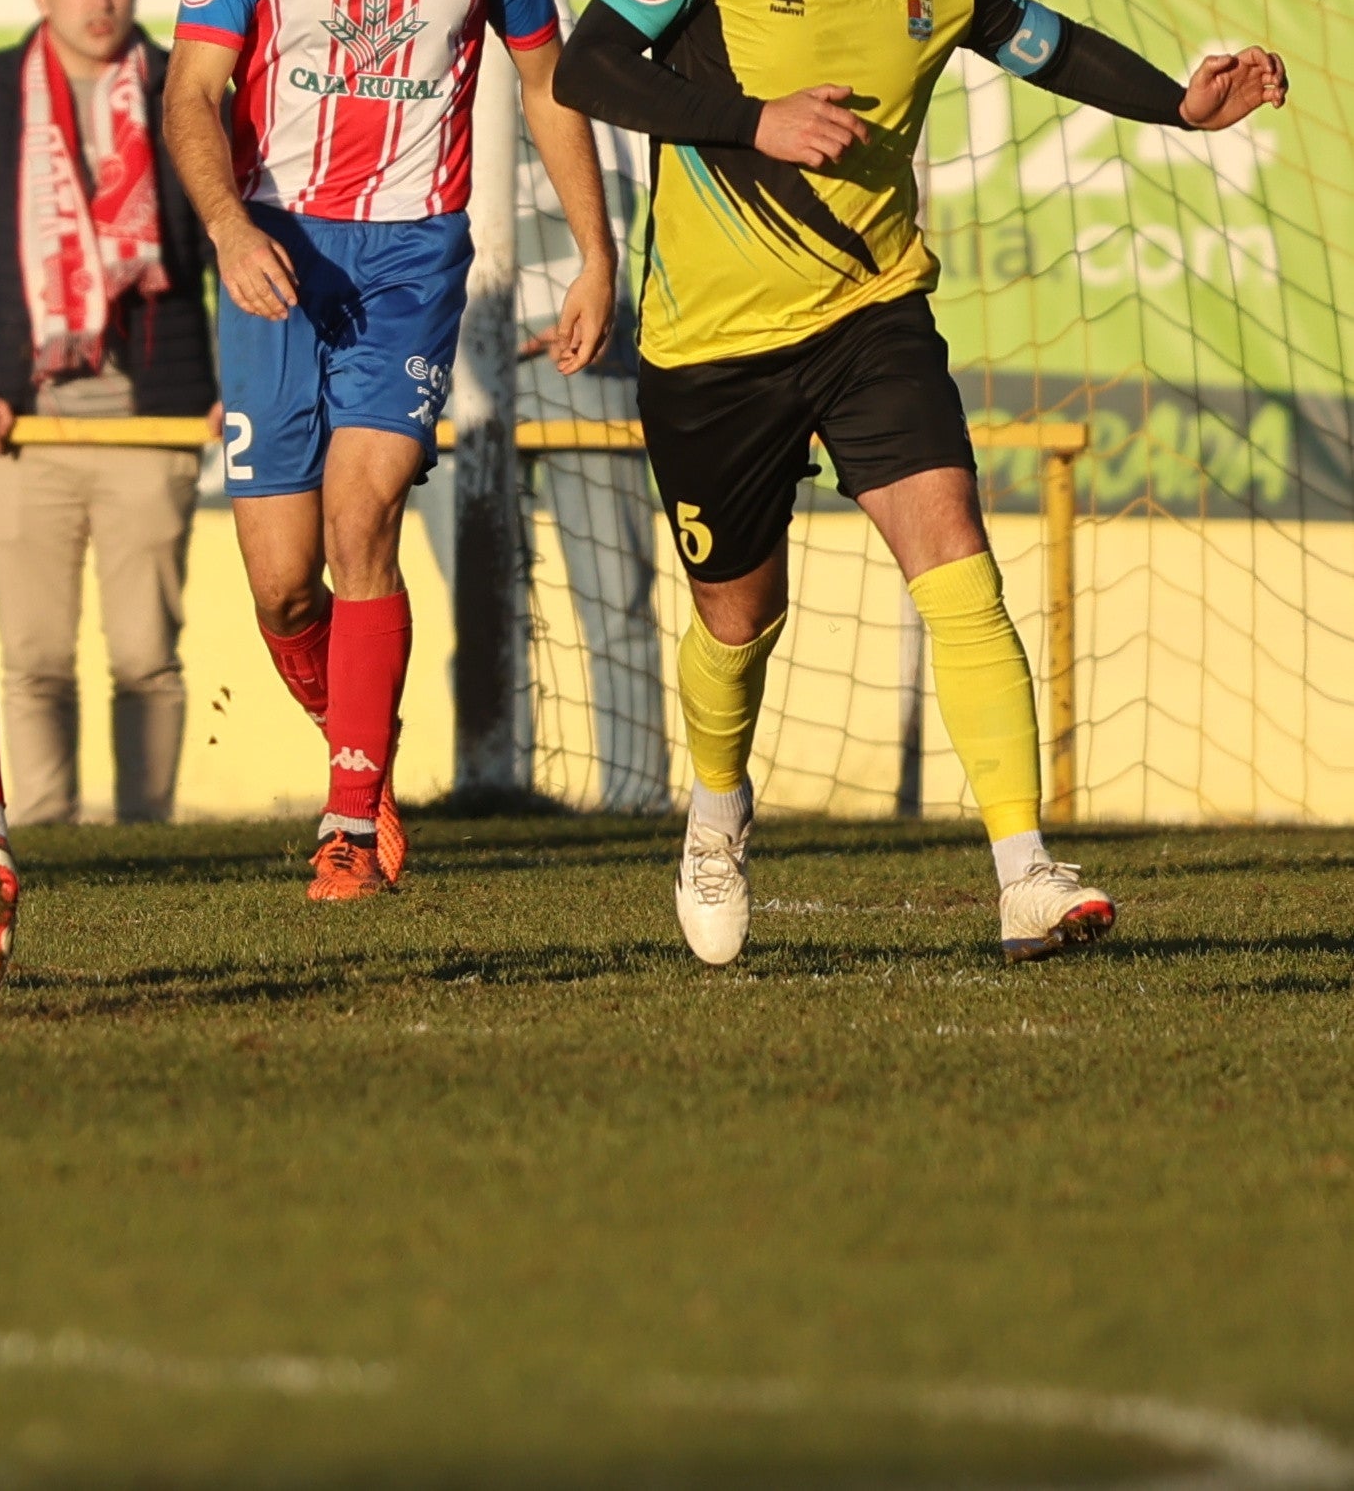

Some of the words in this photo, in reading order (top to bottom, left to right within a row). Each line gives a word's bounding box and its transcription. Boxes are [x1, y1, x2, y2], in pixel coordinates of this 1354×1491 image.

[1010, 29, 1050, 65] C
[289, 67, 349, 95] CAJA
[357, 74, 443, 99] RURAL
[225, 412, 253, 480] 2
[677, 500, 713, 564] 5
